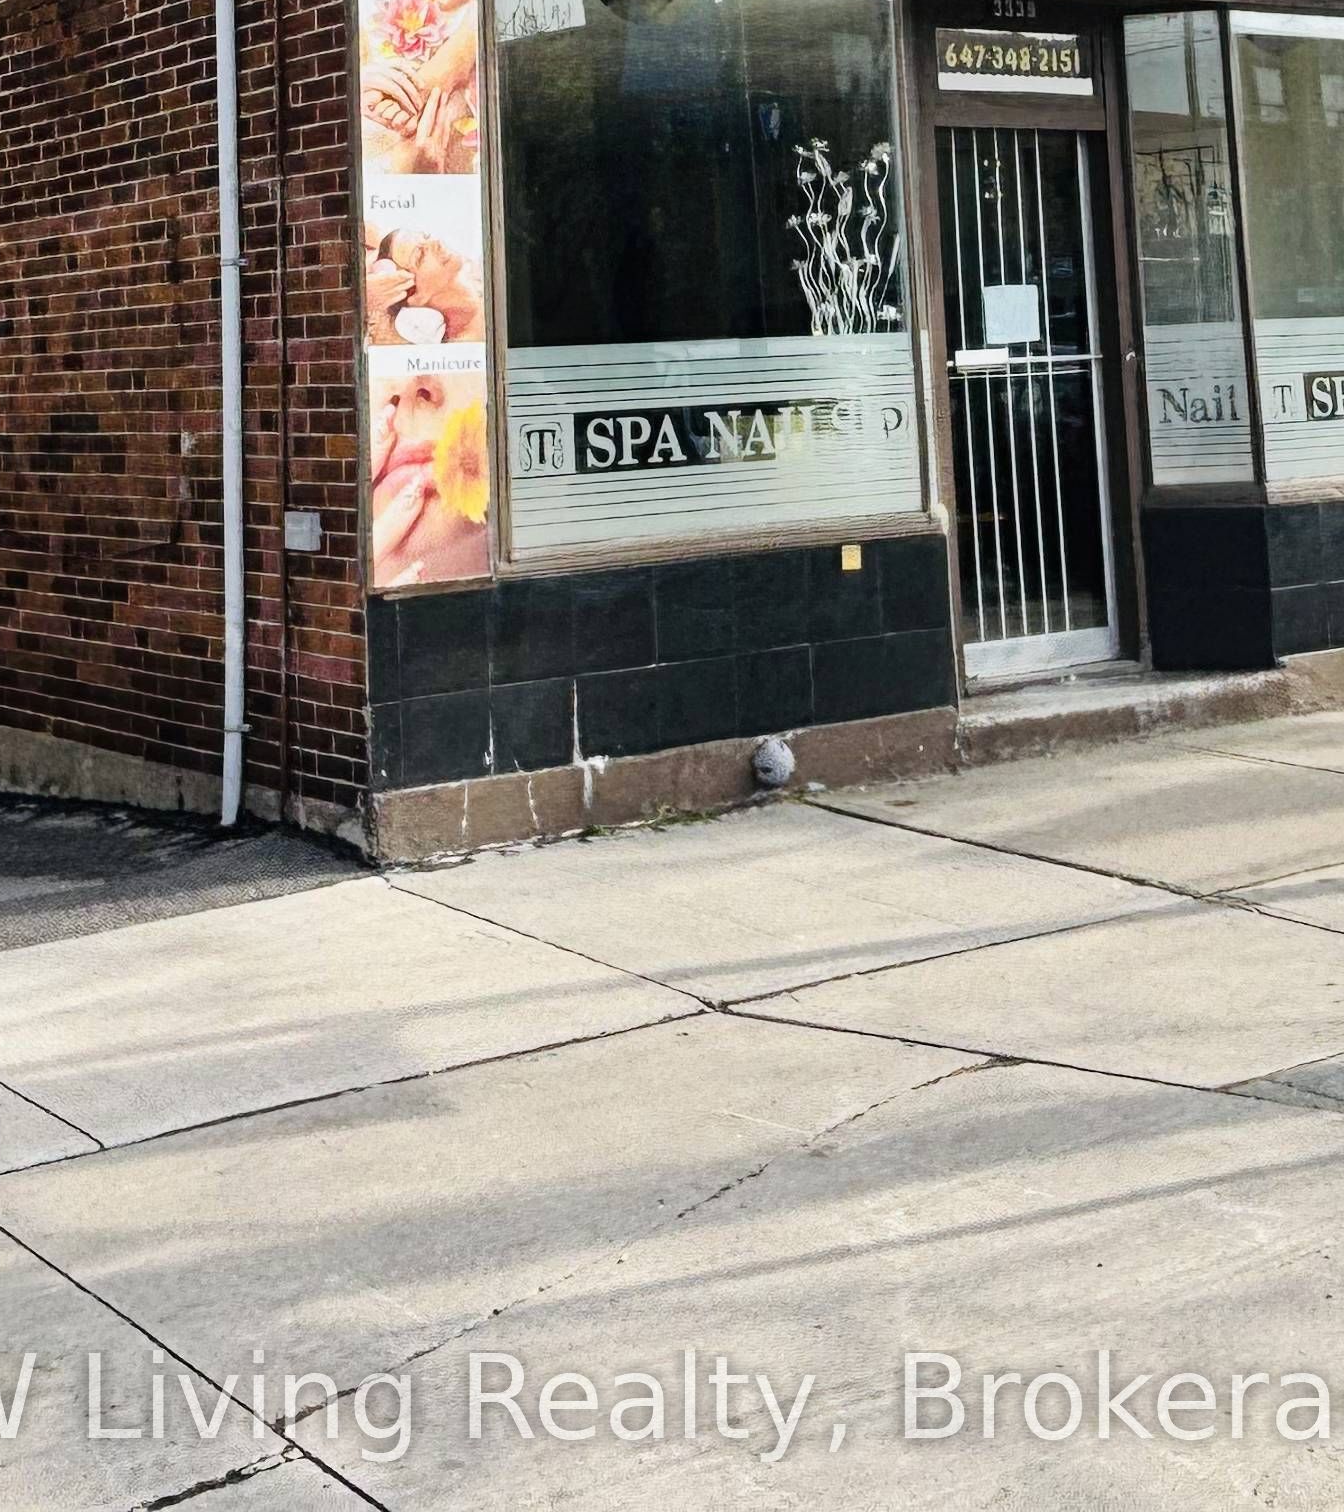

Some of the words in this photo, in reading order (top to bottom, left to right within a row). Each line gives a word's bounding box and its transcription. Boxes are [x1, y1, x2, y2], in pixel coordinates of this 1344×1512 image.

[369, 193, 416, 209] Facial
[406, 357, 481, 372] Manicure
[1157, 384, 1241, 425] Nail
[586, 414, 687, 469] SPA
